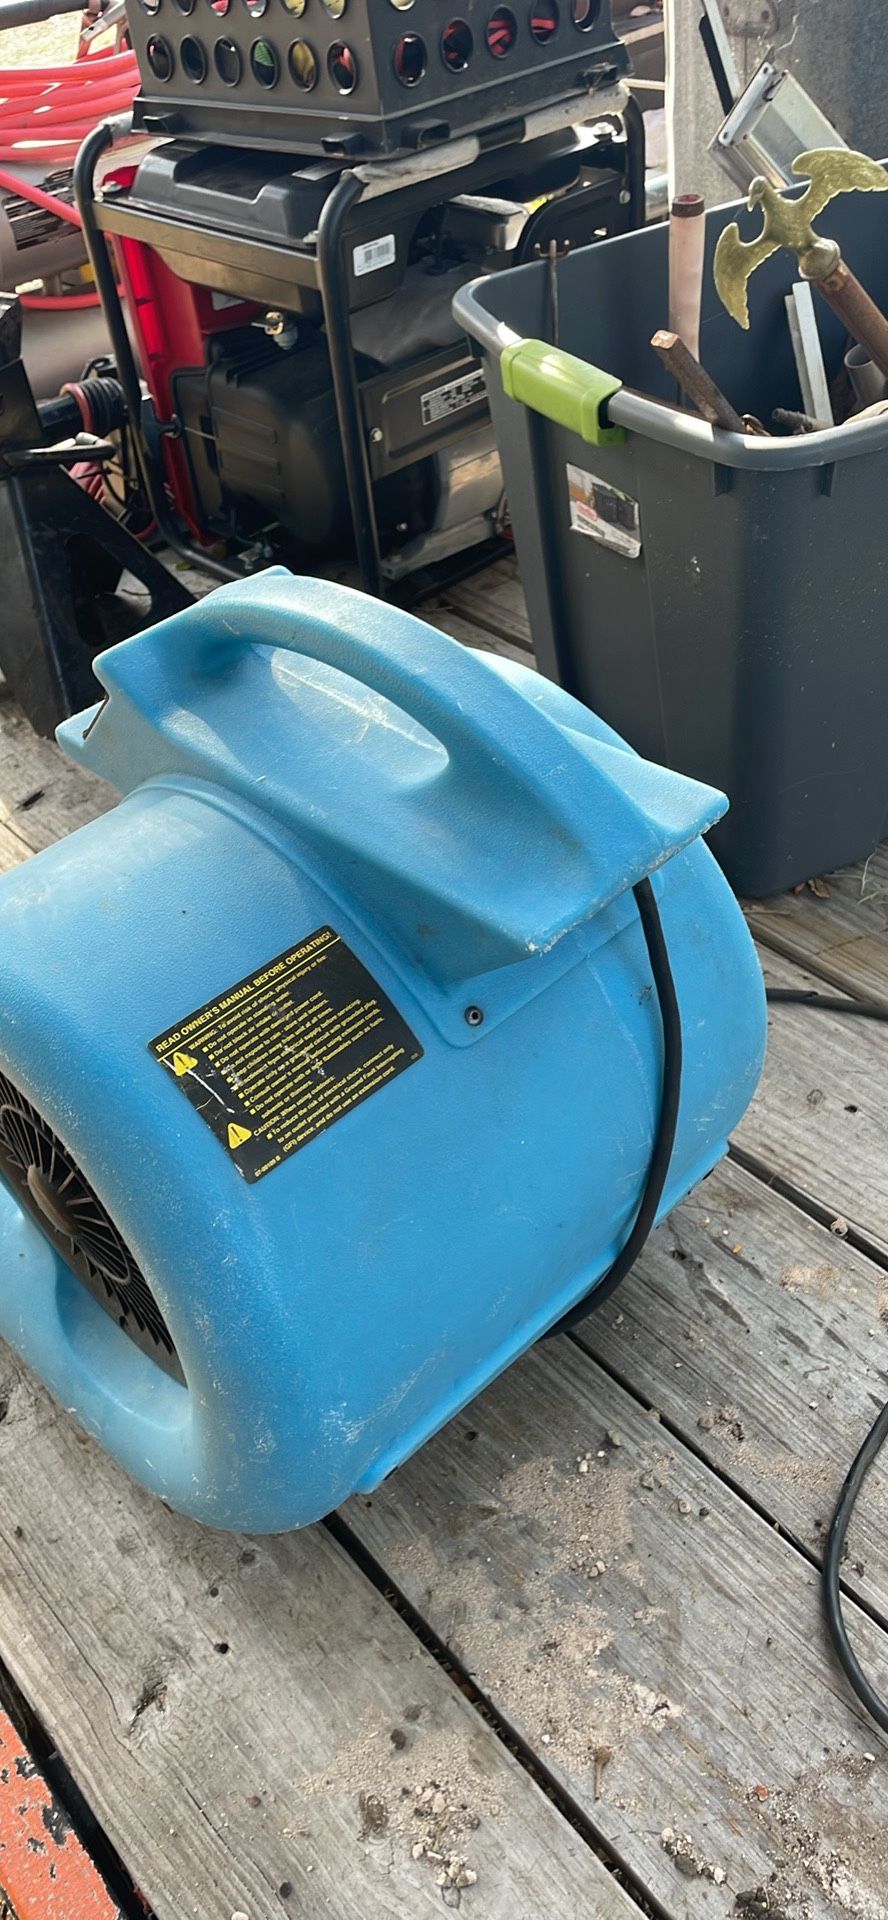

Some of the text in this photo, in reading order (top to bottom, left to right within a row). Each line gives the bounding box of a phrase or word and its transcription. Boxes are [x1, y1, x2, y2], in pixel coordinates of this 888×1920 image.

[155, 931, 331, 1052] READ OWNER'S MANUAL BEFORE OPERATING!
[231, 1066, 247, 1080] eep
